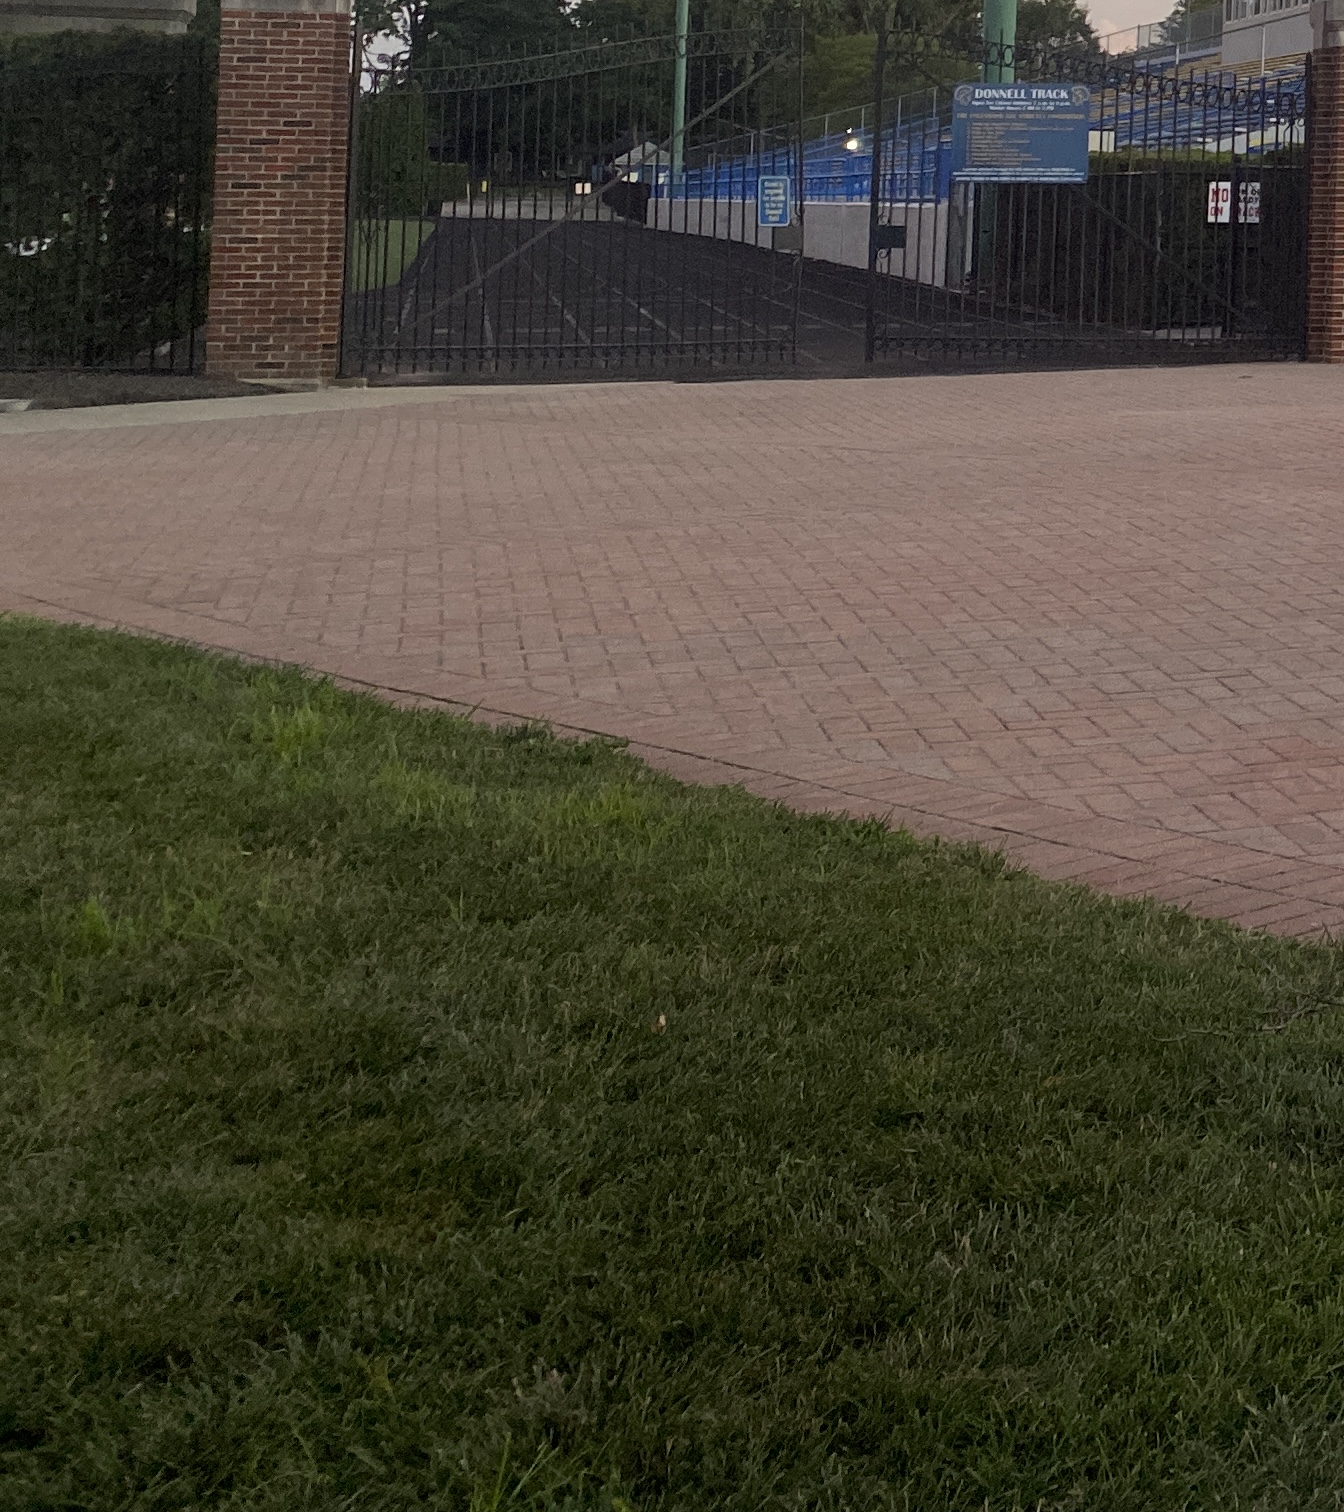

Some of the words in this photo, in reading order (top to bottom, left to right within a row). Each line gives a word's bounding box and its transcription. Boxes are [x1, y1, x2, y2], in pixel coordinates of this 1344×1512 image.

[974, 88, 1027, 99] DONNELL
[1030, 88, 1069, 99] TRACK
[1211, 188, 1228, 202] NO
